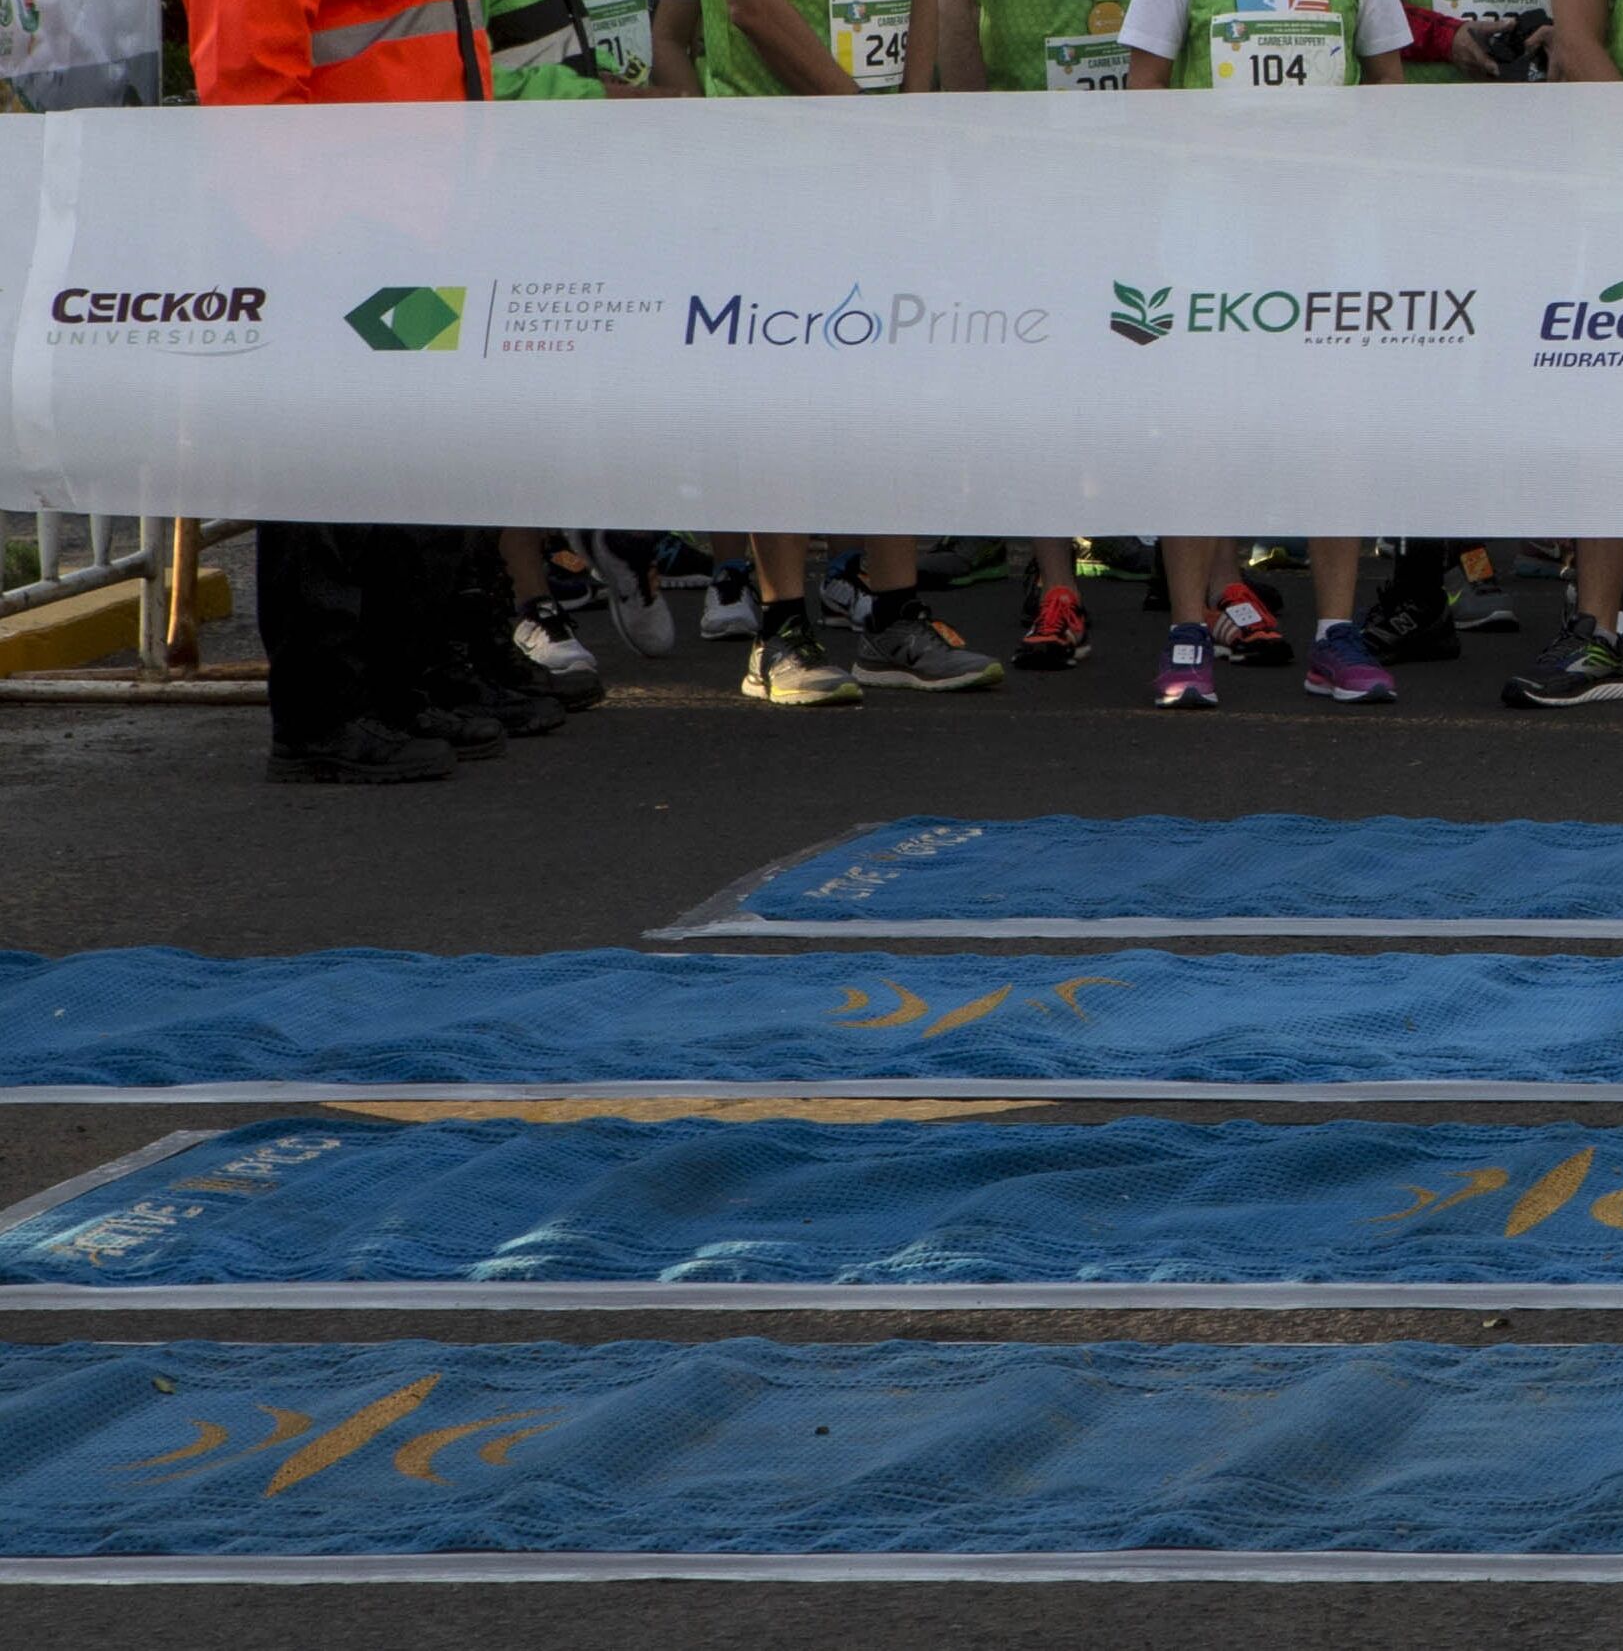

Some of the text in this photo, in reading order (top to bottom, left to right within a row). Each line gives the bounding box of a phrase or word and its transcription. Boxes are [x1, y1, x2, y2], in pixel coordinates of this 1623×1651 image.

[1257, 36, 1326, 47] CARRERA KOPPERT
[1249, 54, 1308, 86] 104
[511, 282, 604, 295] KOPPERT
[52, 287, 266, 324] CEICKOR
[508, 300, 663, 314] DEVELOPMENT
[1188, 290, 1477, 336] EKOFERTIX
[505, 319, 614, 333] INSTITUTE
[45, 330, 263, 347] UNIVERSIDAD
[502, 340, 574, 352] BERRIES
